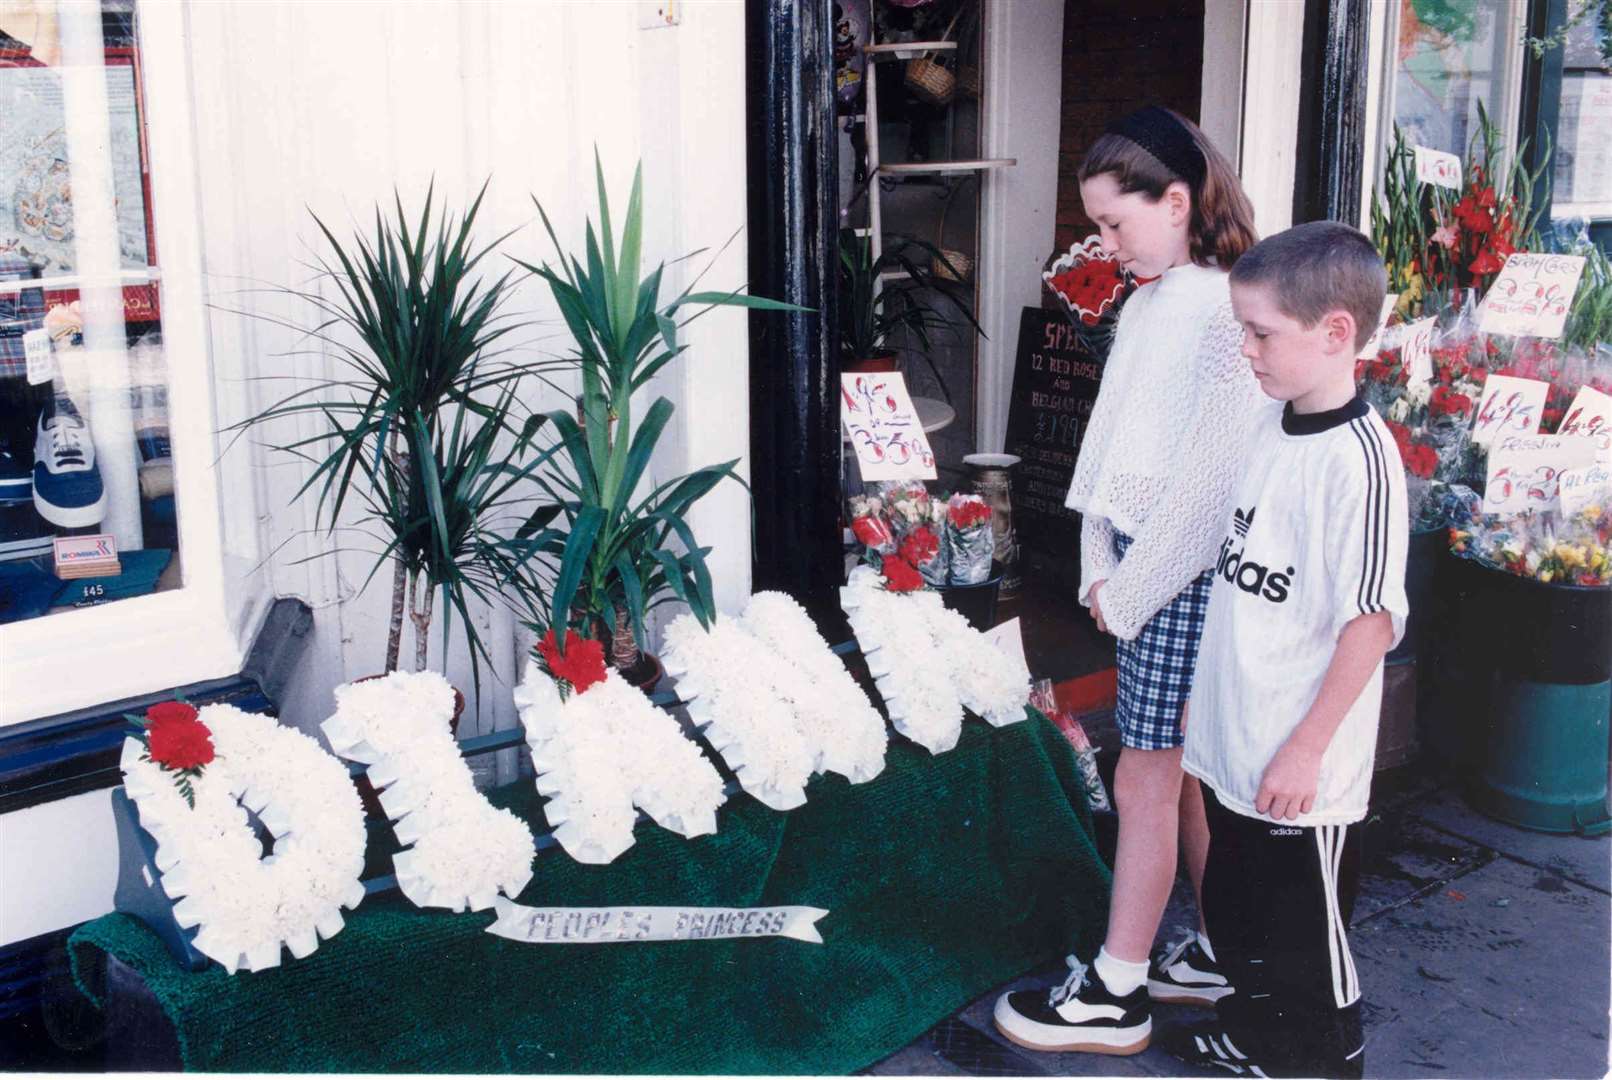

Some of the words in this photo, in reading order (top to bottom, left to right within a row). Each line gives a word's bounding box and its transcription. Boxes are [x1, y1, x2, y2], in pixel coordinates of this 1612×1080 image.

[1031, 353, 1043, 371] 12
[1049, 357, 1071, 375] RED
[1072, 362, 1101, 382] ROSE
[83, 585, 104, 597] £45
[1270, 828, 1303, 836] adidas
[674, 911, 787, 939] PRINCESS
